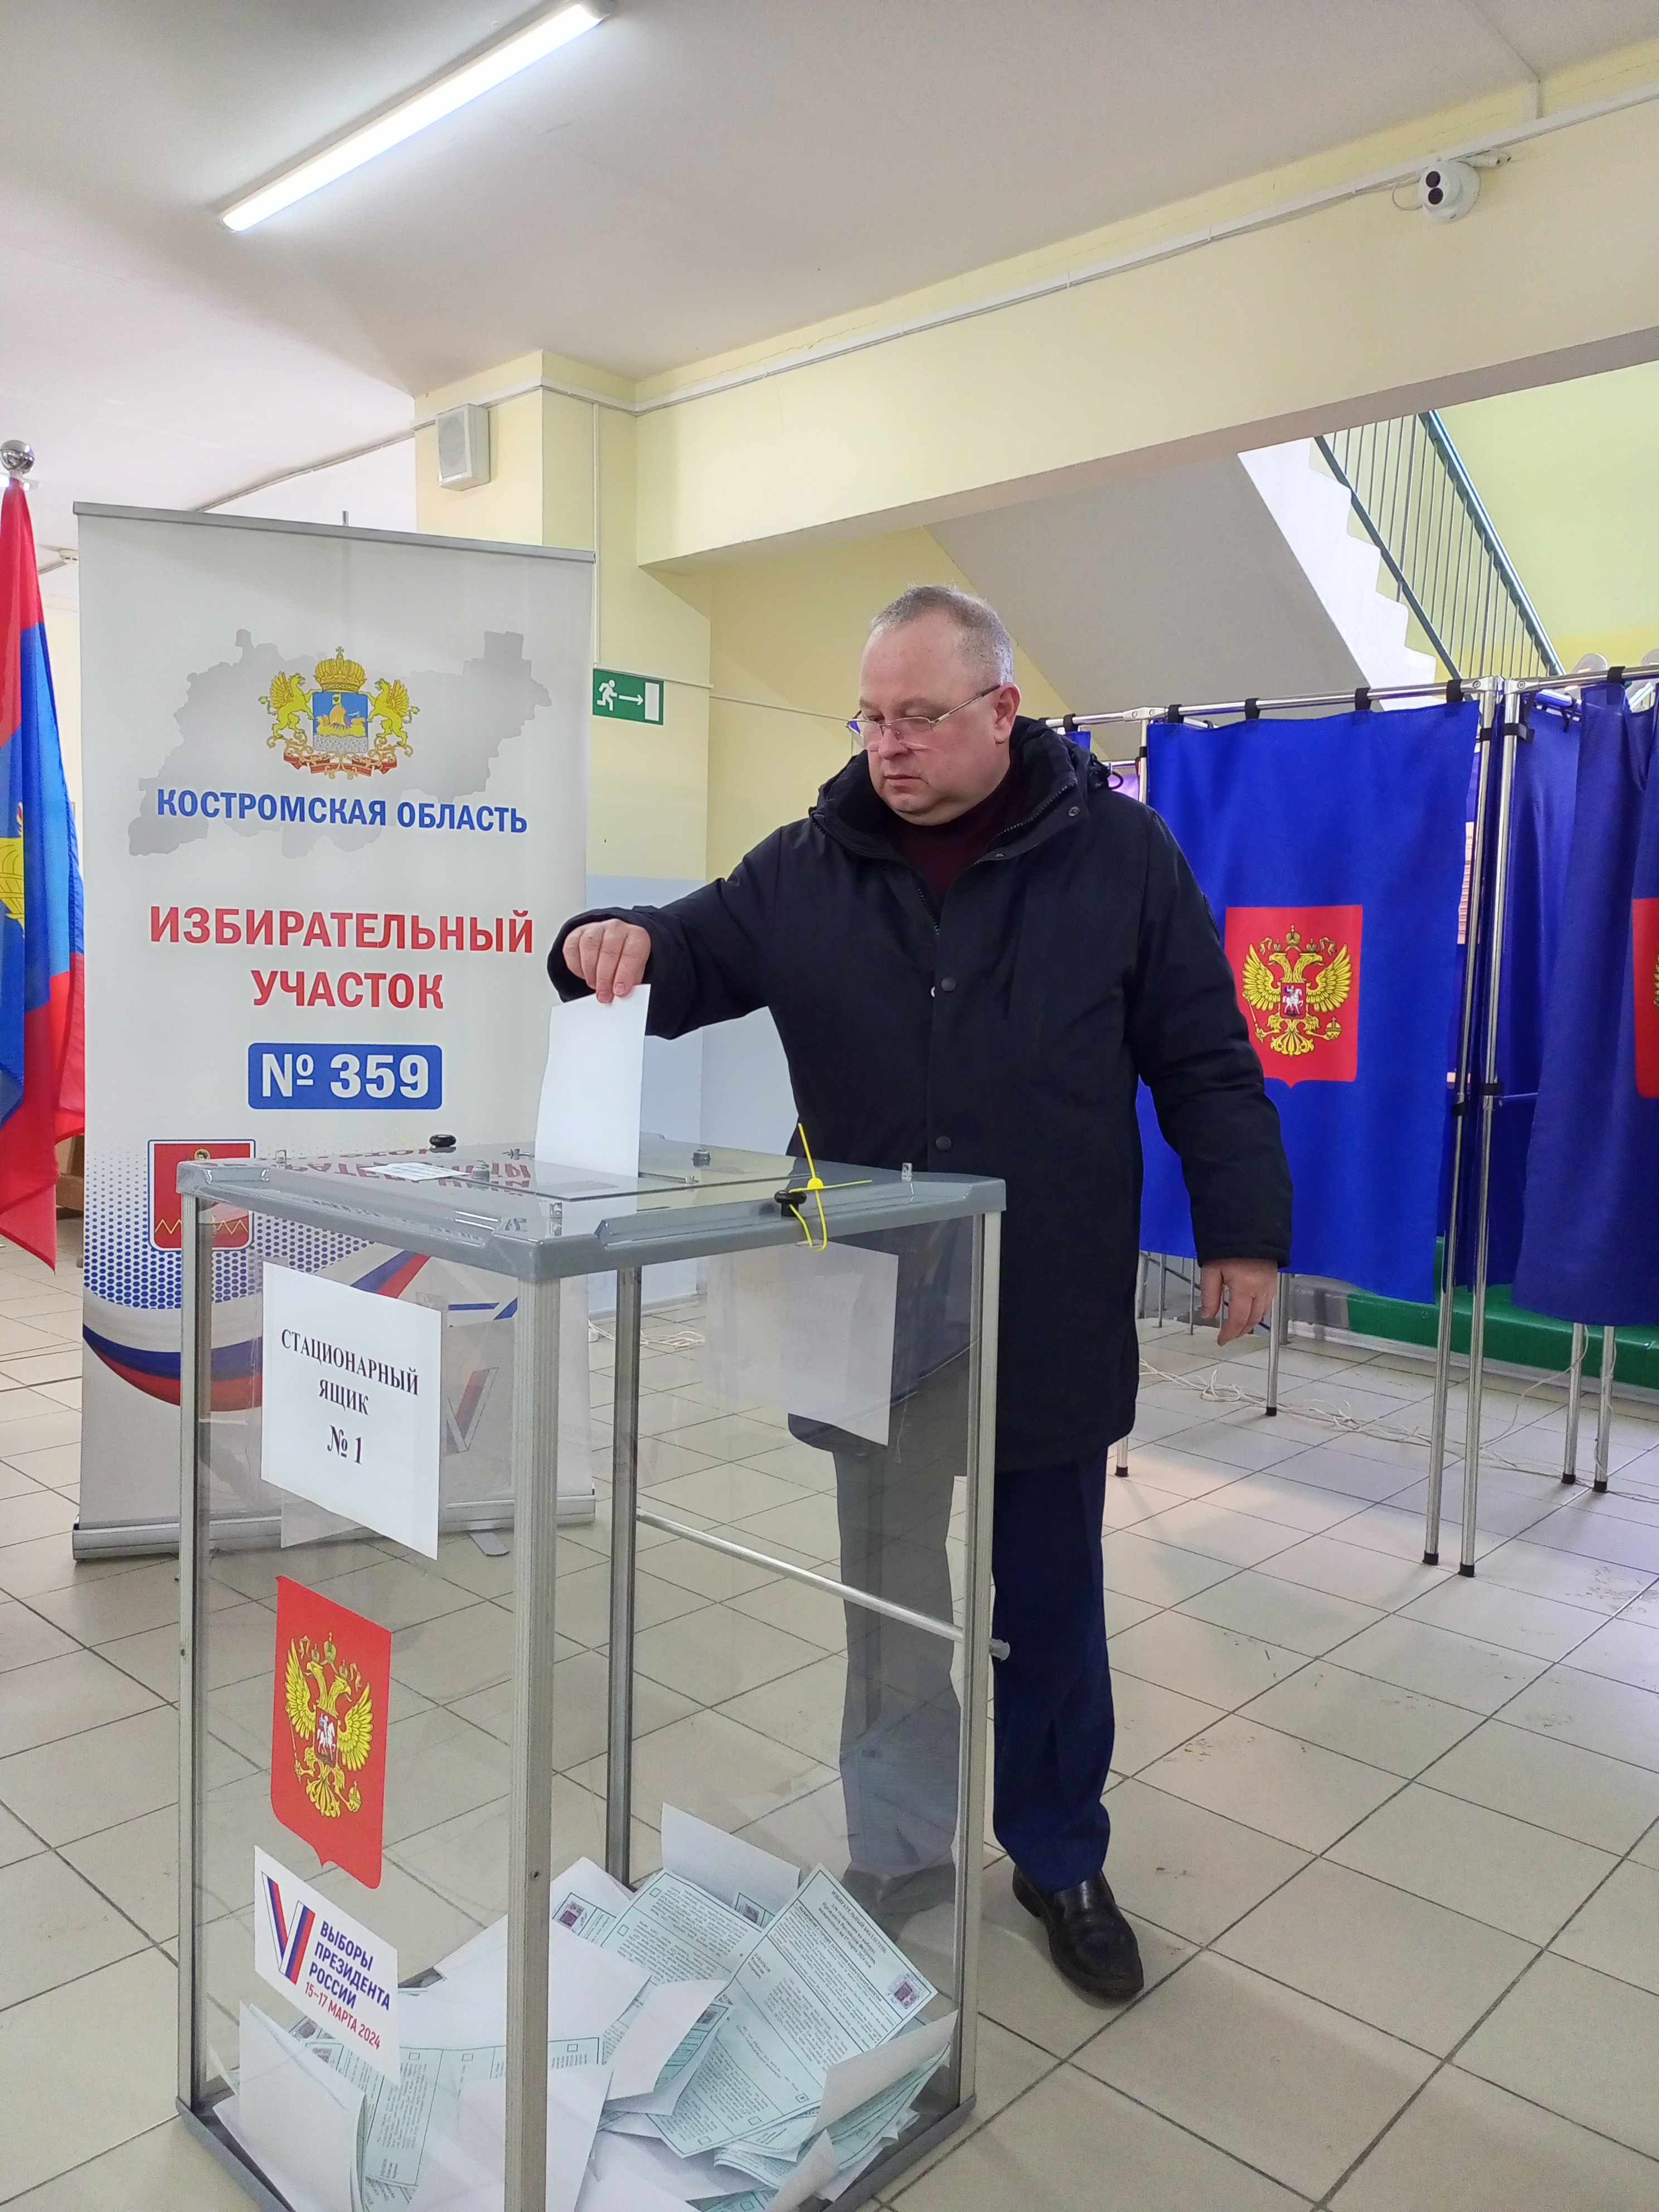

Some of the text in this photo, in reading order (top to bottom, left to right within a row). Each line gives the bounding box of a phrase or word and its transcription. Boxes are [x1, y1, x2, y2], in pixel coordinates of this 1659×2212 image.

[157, 788, 527, 834] КОСТРОМСКАЯ ОБЛАСТЬ
[150, 906, 533, 954] ИЗБИРАТЕЛЬНЫЙ
[251, 970, 444, 1010] УЧАСТОК
[261, 1052, 430, 1099] № 359
[282, 1329, 419, 1396] СТАЦИОНАРНЫЙ
[319, 1379, 368, 1415] ЯЩИК
[354, 1437, 362, 1465] 1
[320, 1920, 373, 1972] ВЫБОРЫ
[309, 1961, 357, 2010] РОССИИ
[314, 1941, 391, 2011] ПРЕЗИДЕНТА
[328, 1999, 357, 2032] МАРТА
[358, 2024, 381, 2050] 2024
